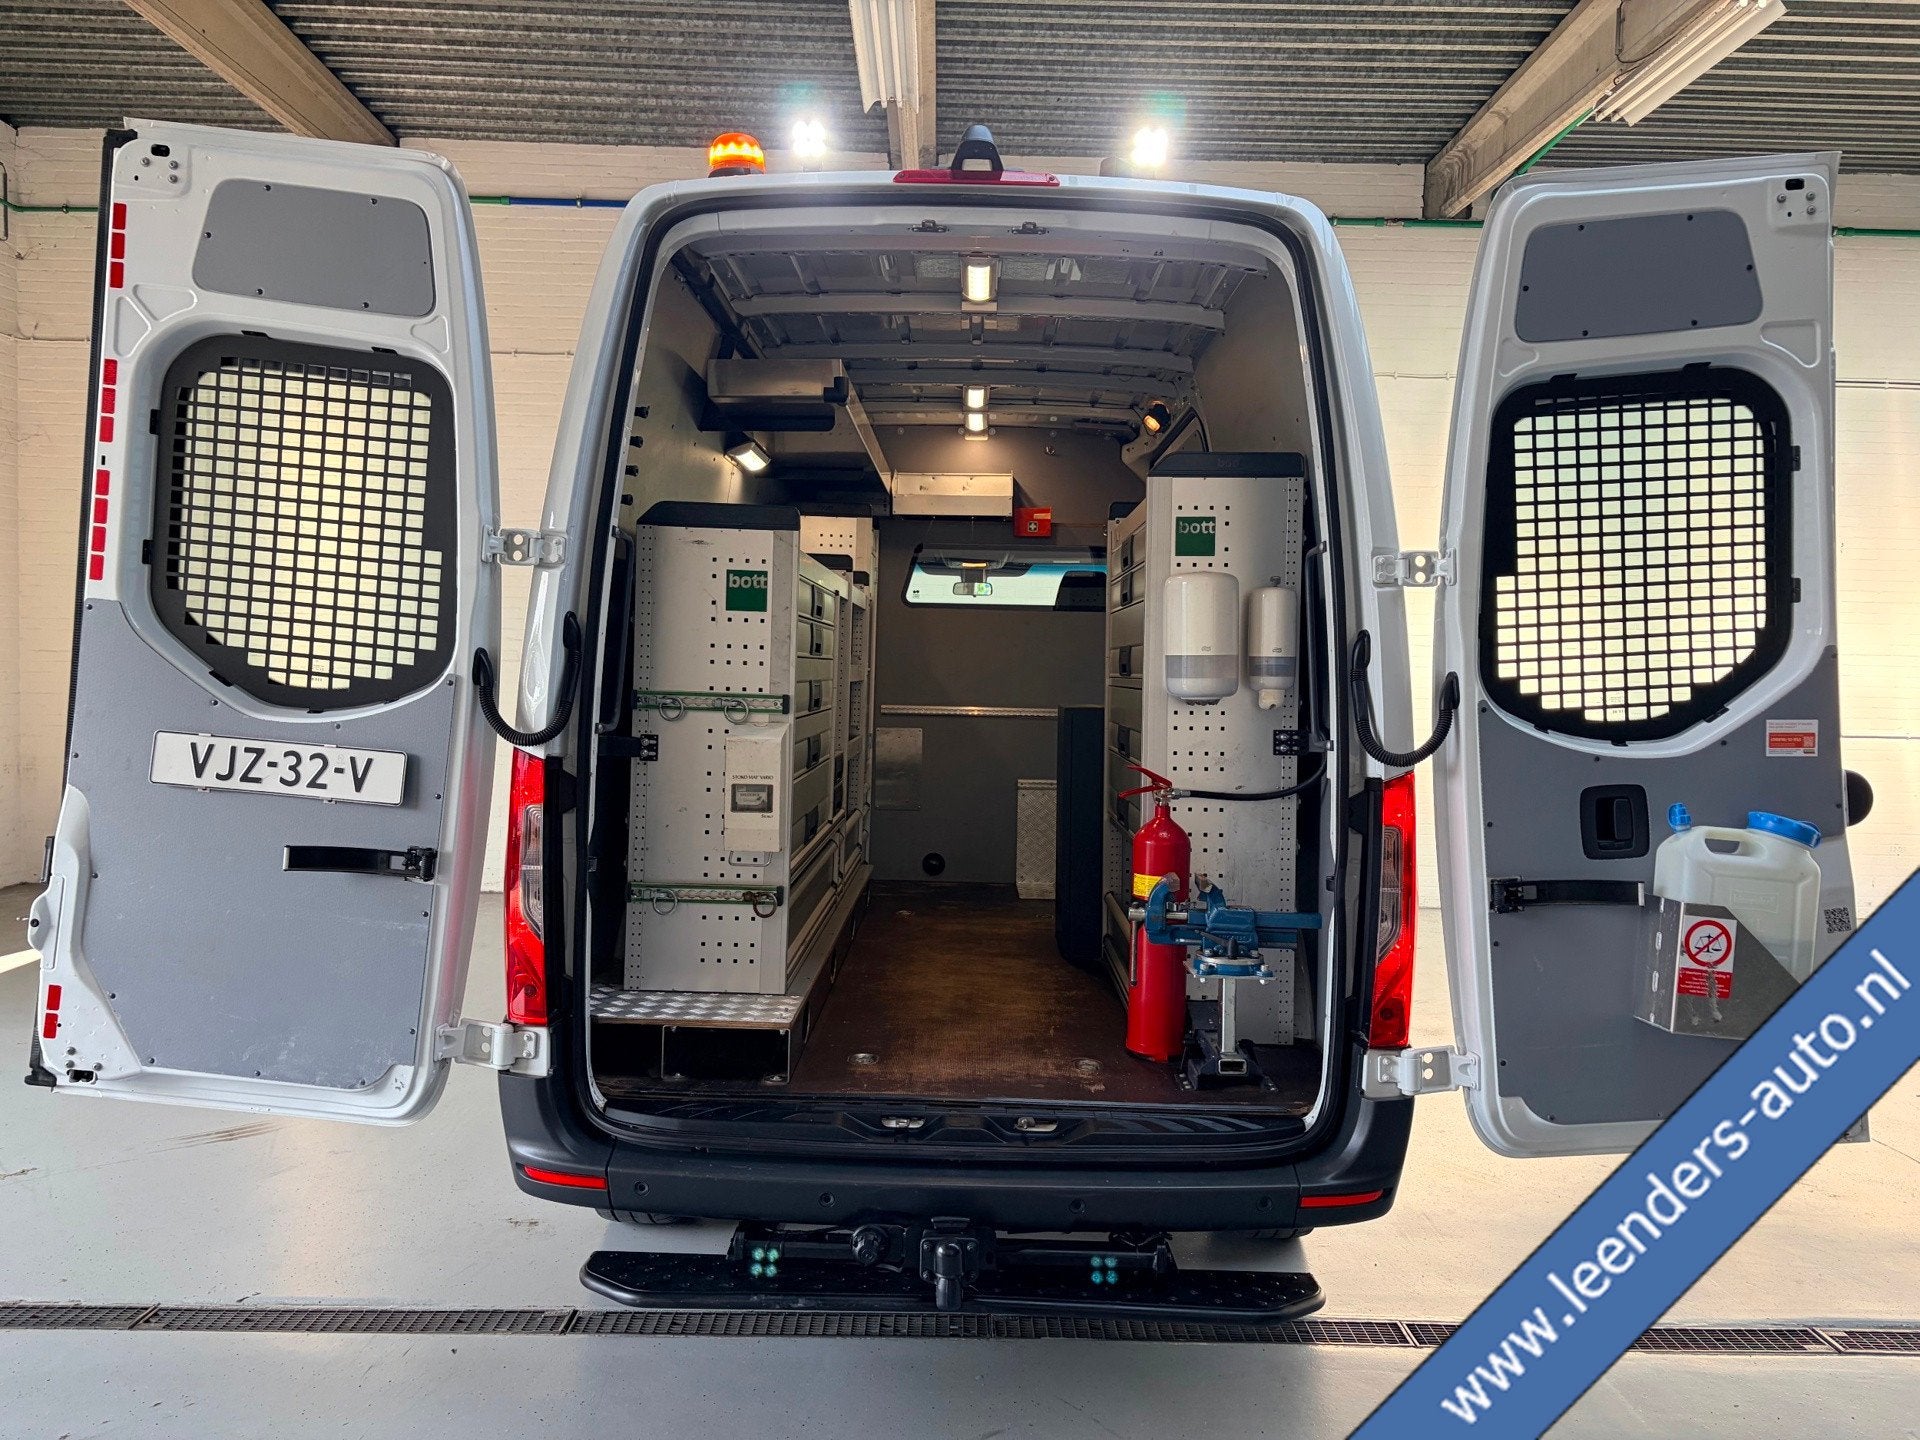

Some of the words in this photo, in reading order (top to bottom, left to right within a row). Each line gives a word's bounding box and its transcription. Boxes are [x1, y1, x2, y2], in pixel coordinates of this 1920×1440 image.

[1180, 520, 1215, 534] bott
[729, 573, 768, 589] bott
[190, 742, 373, 793] VJZ-32-V
